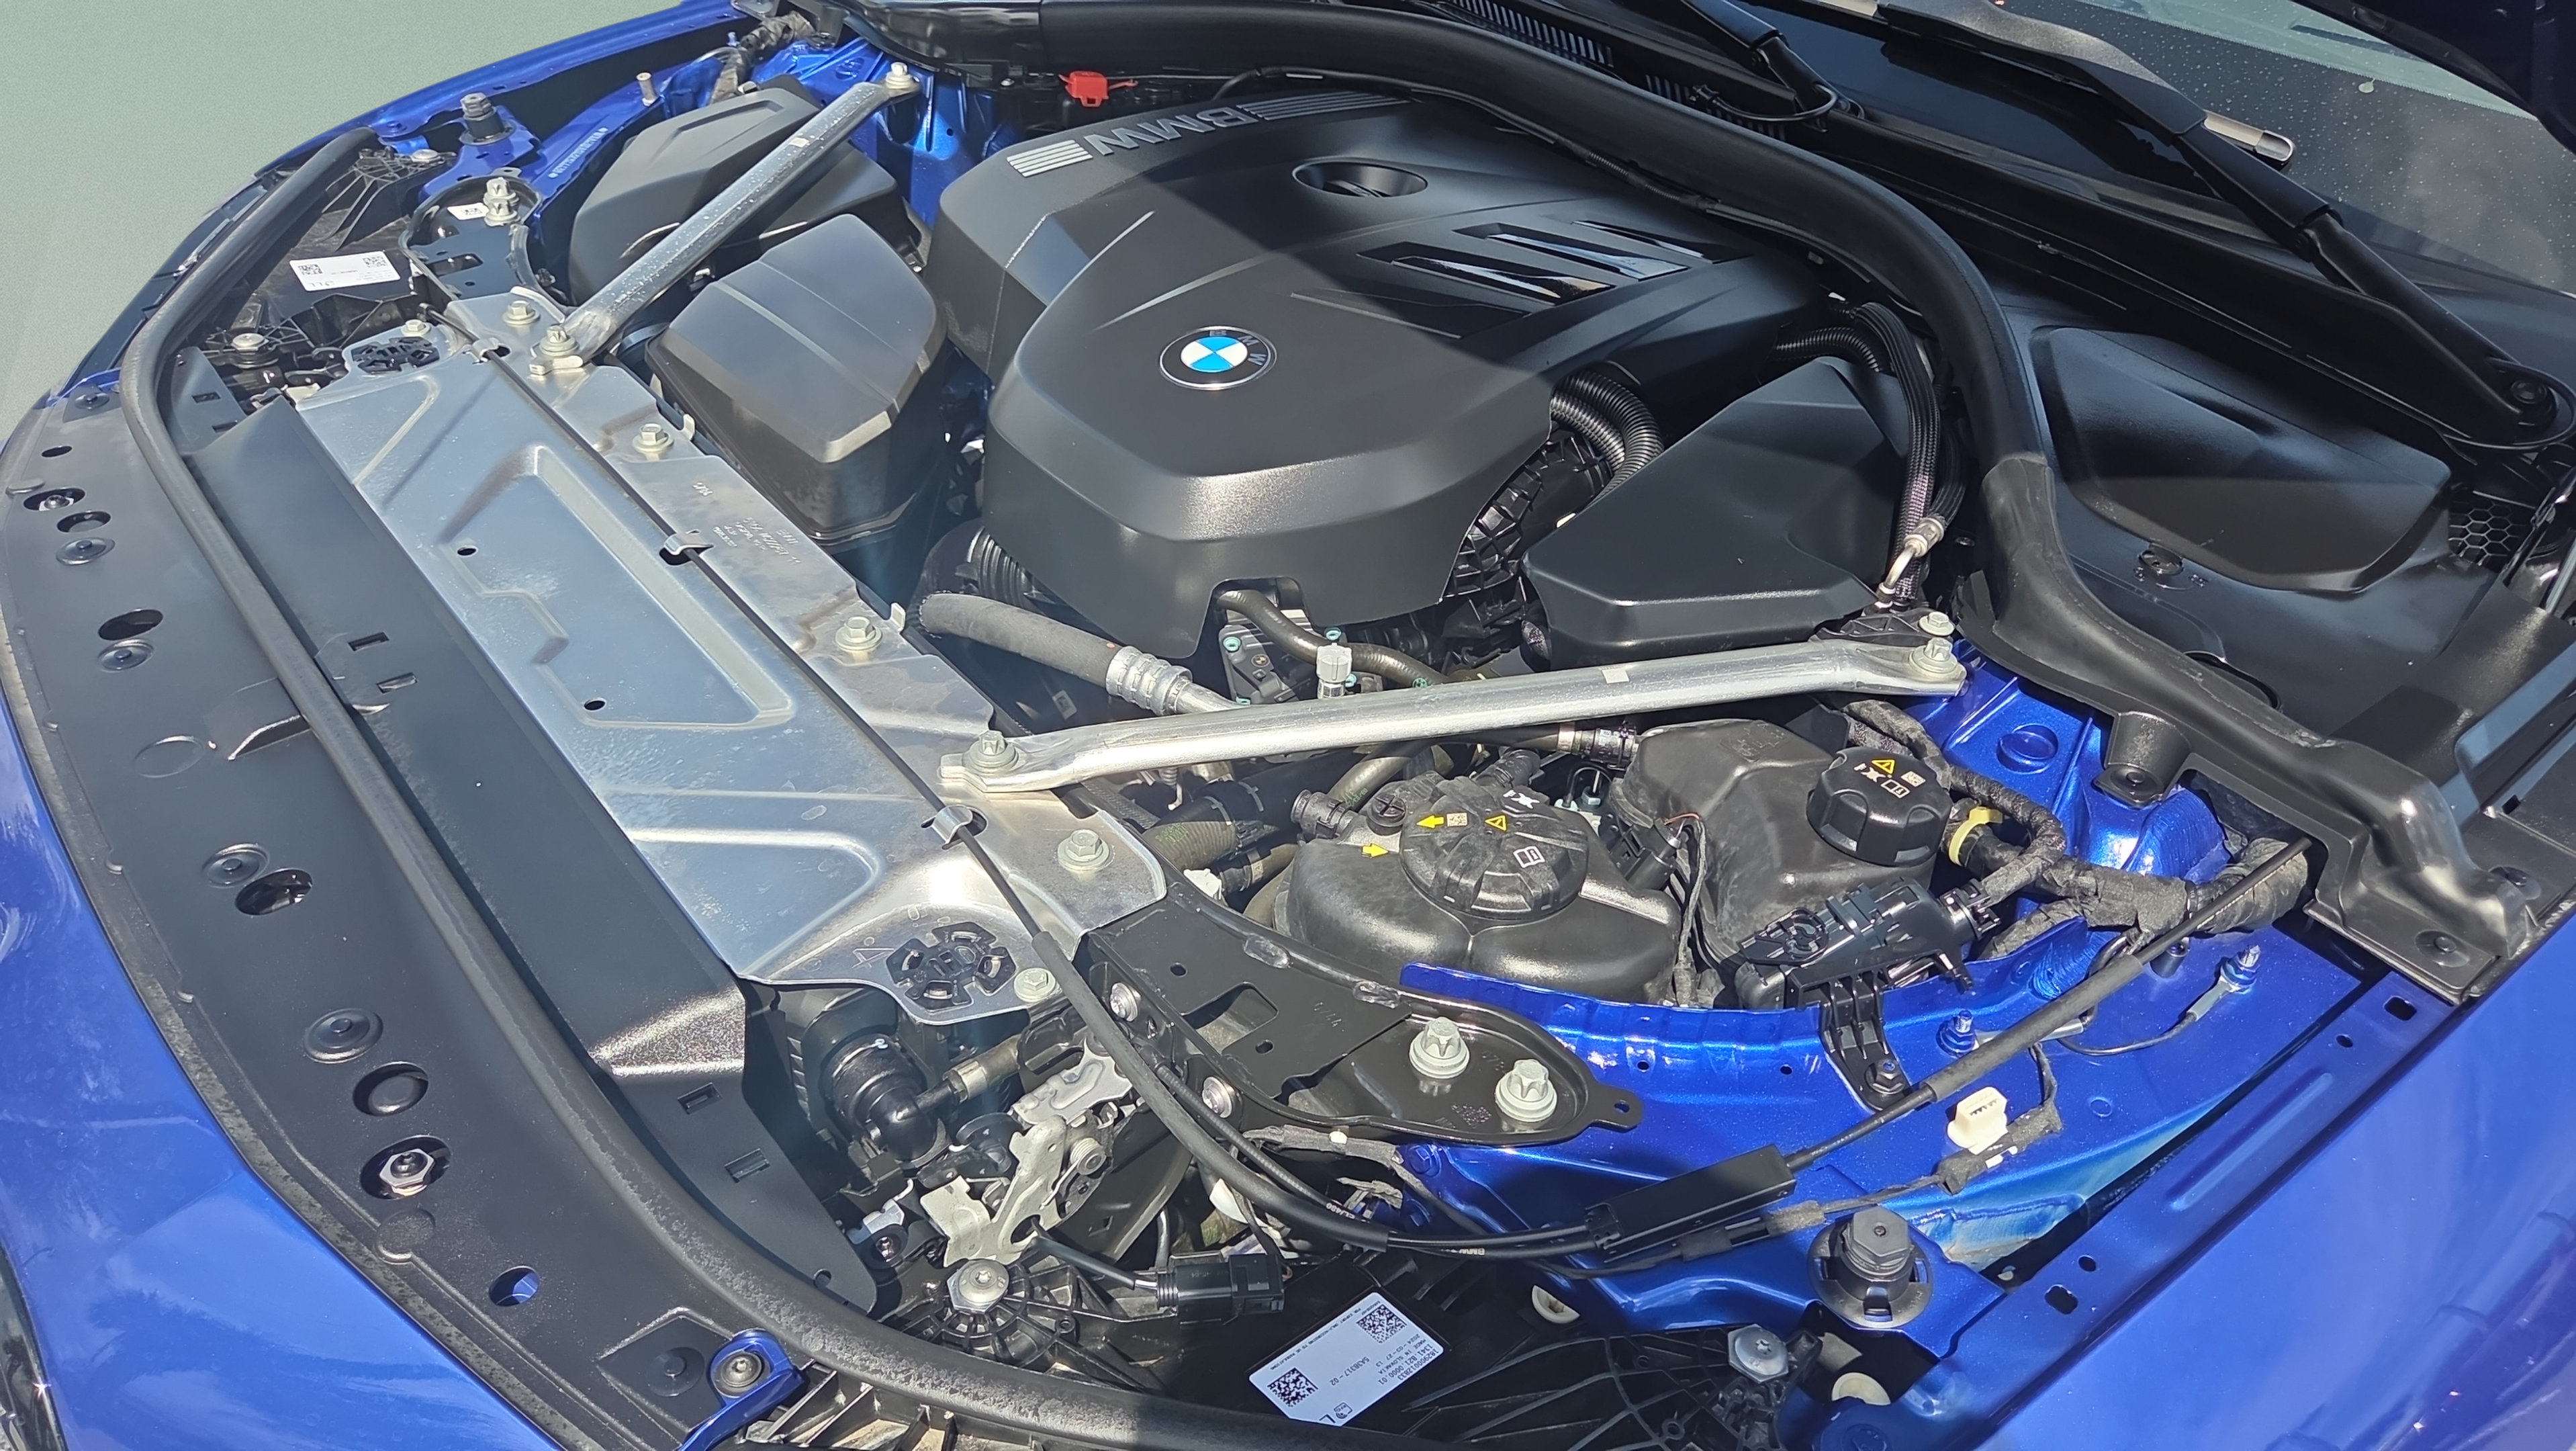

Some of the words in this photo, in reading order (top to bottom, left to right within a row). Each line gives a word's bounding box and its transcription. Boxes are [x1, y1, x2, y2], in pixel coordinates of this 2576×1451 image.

[1084, 107, 1258, 156] BMW
[1209, 330, 1267, 366] BMW
[1413, 1338, 1426, 1349] MADE
[1377, 1355, 1404, 1374] SLOVAKIA
